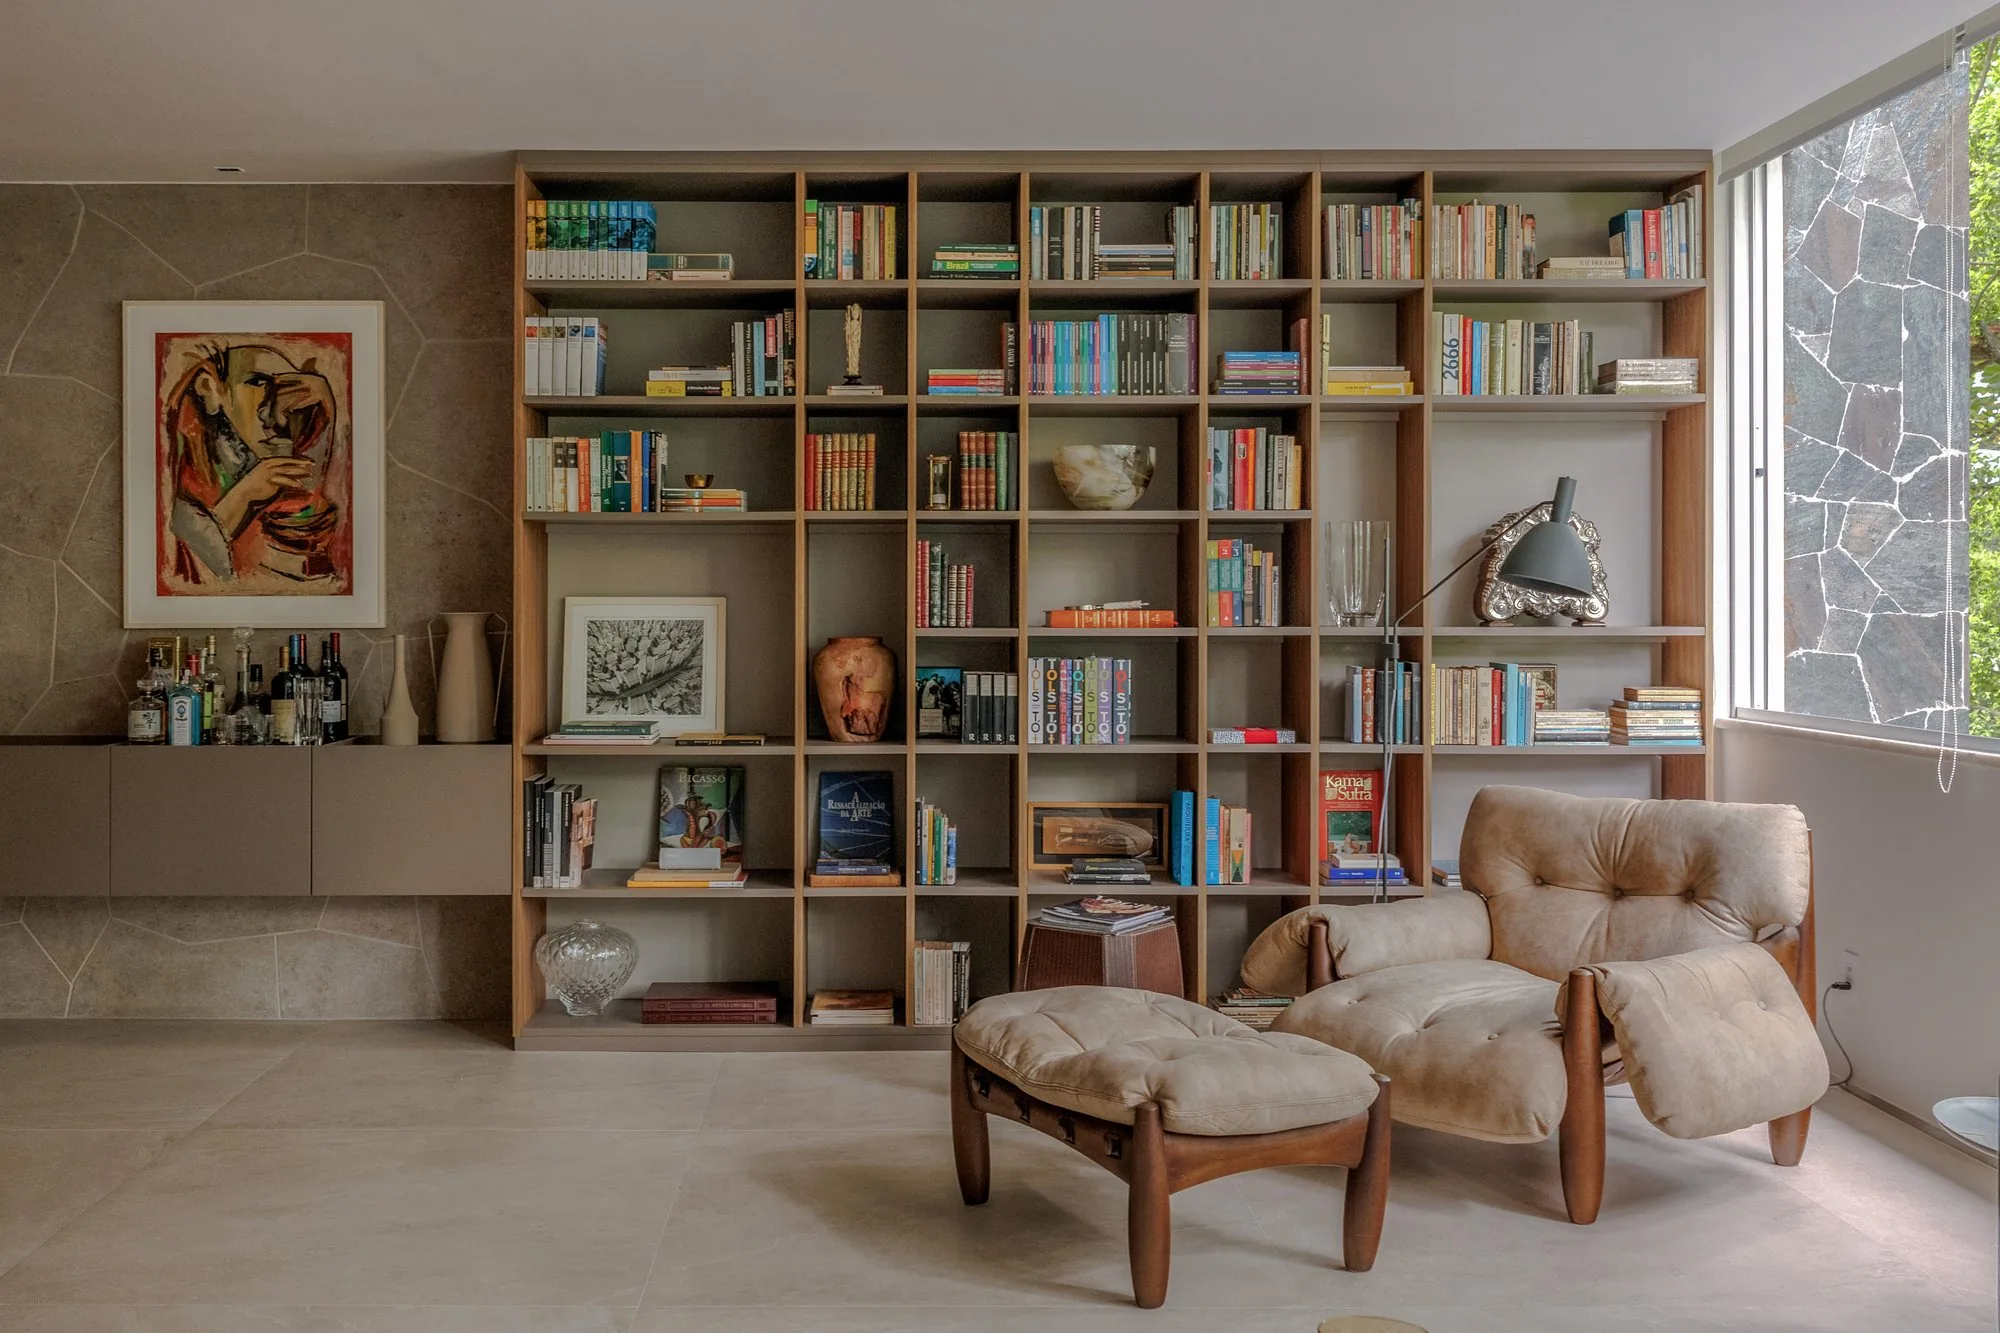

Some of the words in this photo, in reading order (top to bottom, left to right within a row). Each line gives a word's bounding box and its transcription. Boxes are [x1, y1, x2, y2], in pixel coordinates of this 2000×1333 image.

[1648, 214, 1656, 240] BLAKE
[945, 261, 969, 270] Brazil
[1442, 338, 1459, 380] 2666
[1232, 549, 1239, 557] 3
[968, 733, 975, 741] R
[982, 733, 989, 741] R
[995, 733, 1002, 741] R
[1009, 734, 1016, 742] R
[678, 773, 726, 783] PICASSO
[1325, 774, 1365, 788] Kama
[852, 791, 859, 802] A
[1337, 786, 1373, 801] Sutra
[850, 808, 873, 822] ARTE
